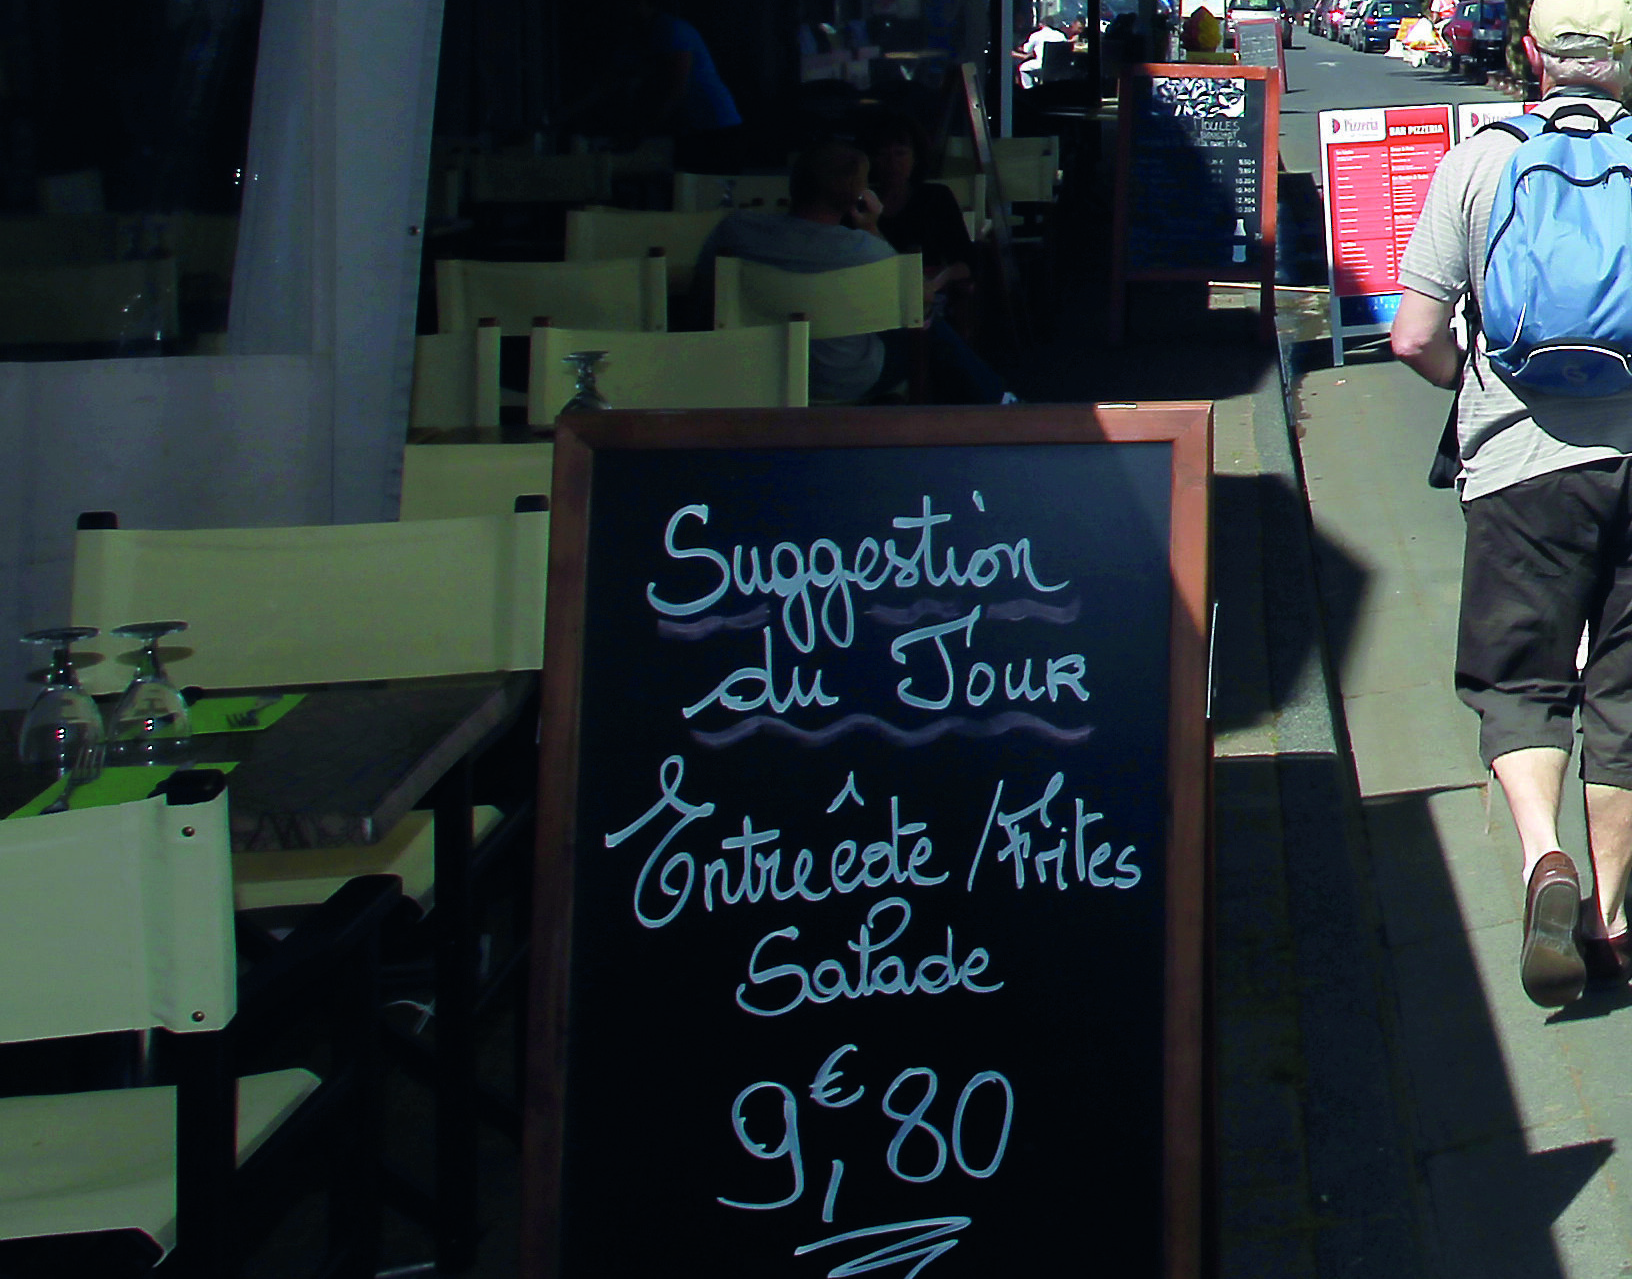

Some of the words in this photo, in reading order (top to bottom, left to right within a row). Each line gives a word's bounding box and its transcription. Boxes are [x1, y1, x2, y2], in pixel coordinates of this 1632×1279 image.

[1408, 123, 1444, 135] PIZZERIA
[645, 490, 1071, 653] Suggestion
[682, 626, 839, 719] du
[736, 896, 1005, 1017] Salade
